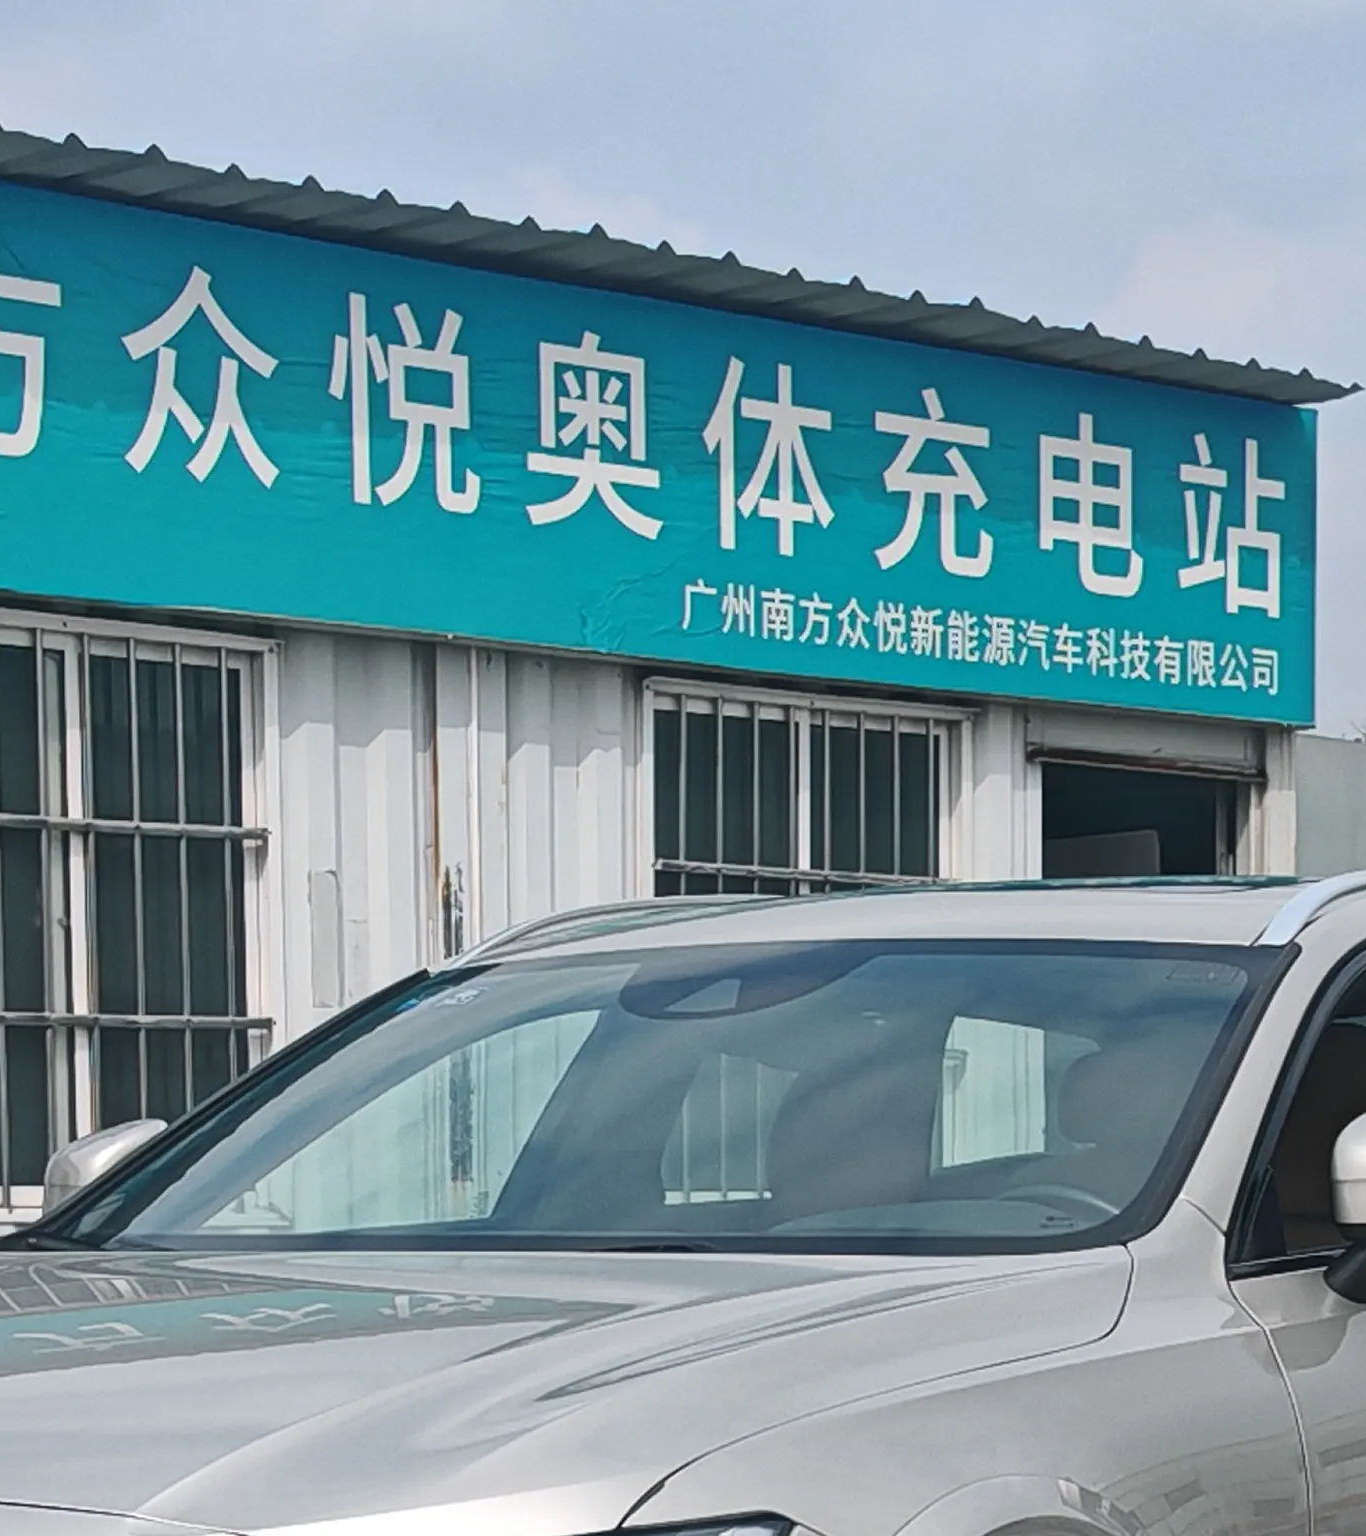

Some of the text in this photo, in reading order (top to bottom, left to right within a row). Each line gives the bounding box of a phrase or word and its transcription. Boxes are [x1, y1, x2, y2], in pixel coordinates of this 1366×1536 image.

[681, 578, 1280, 696] 广州南方众悦新能源汽车科技有限公司
